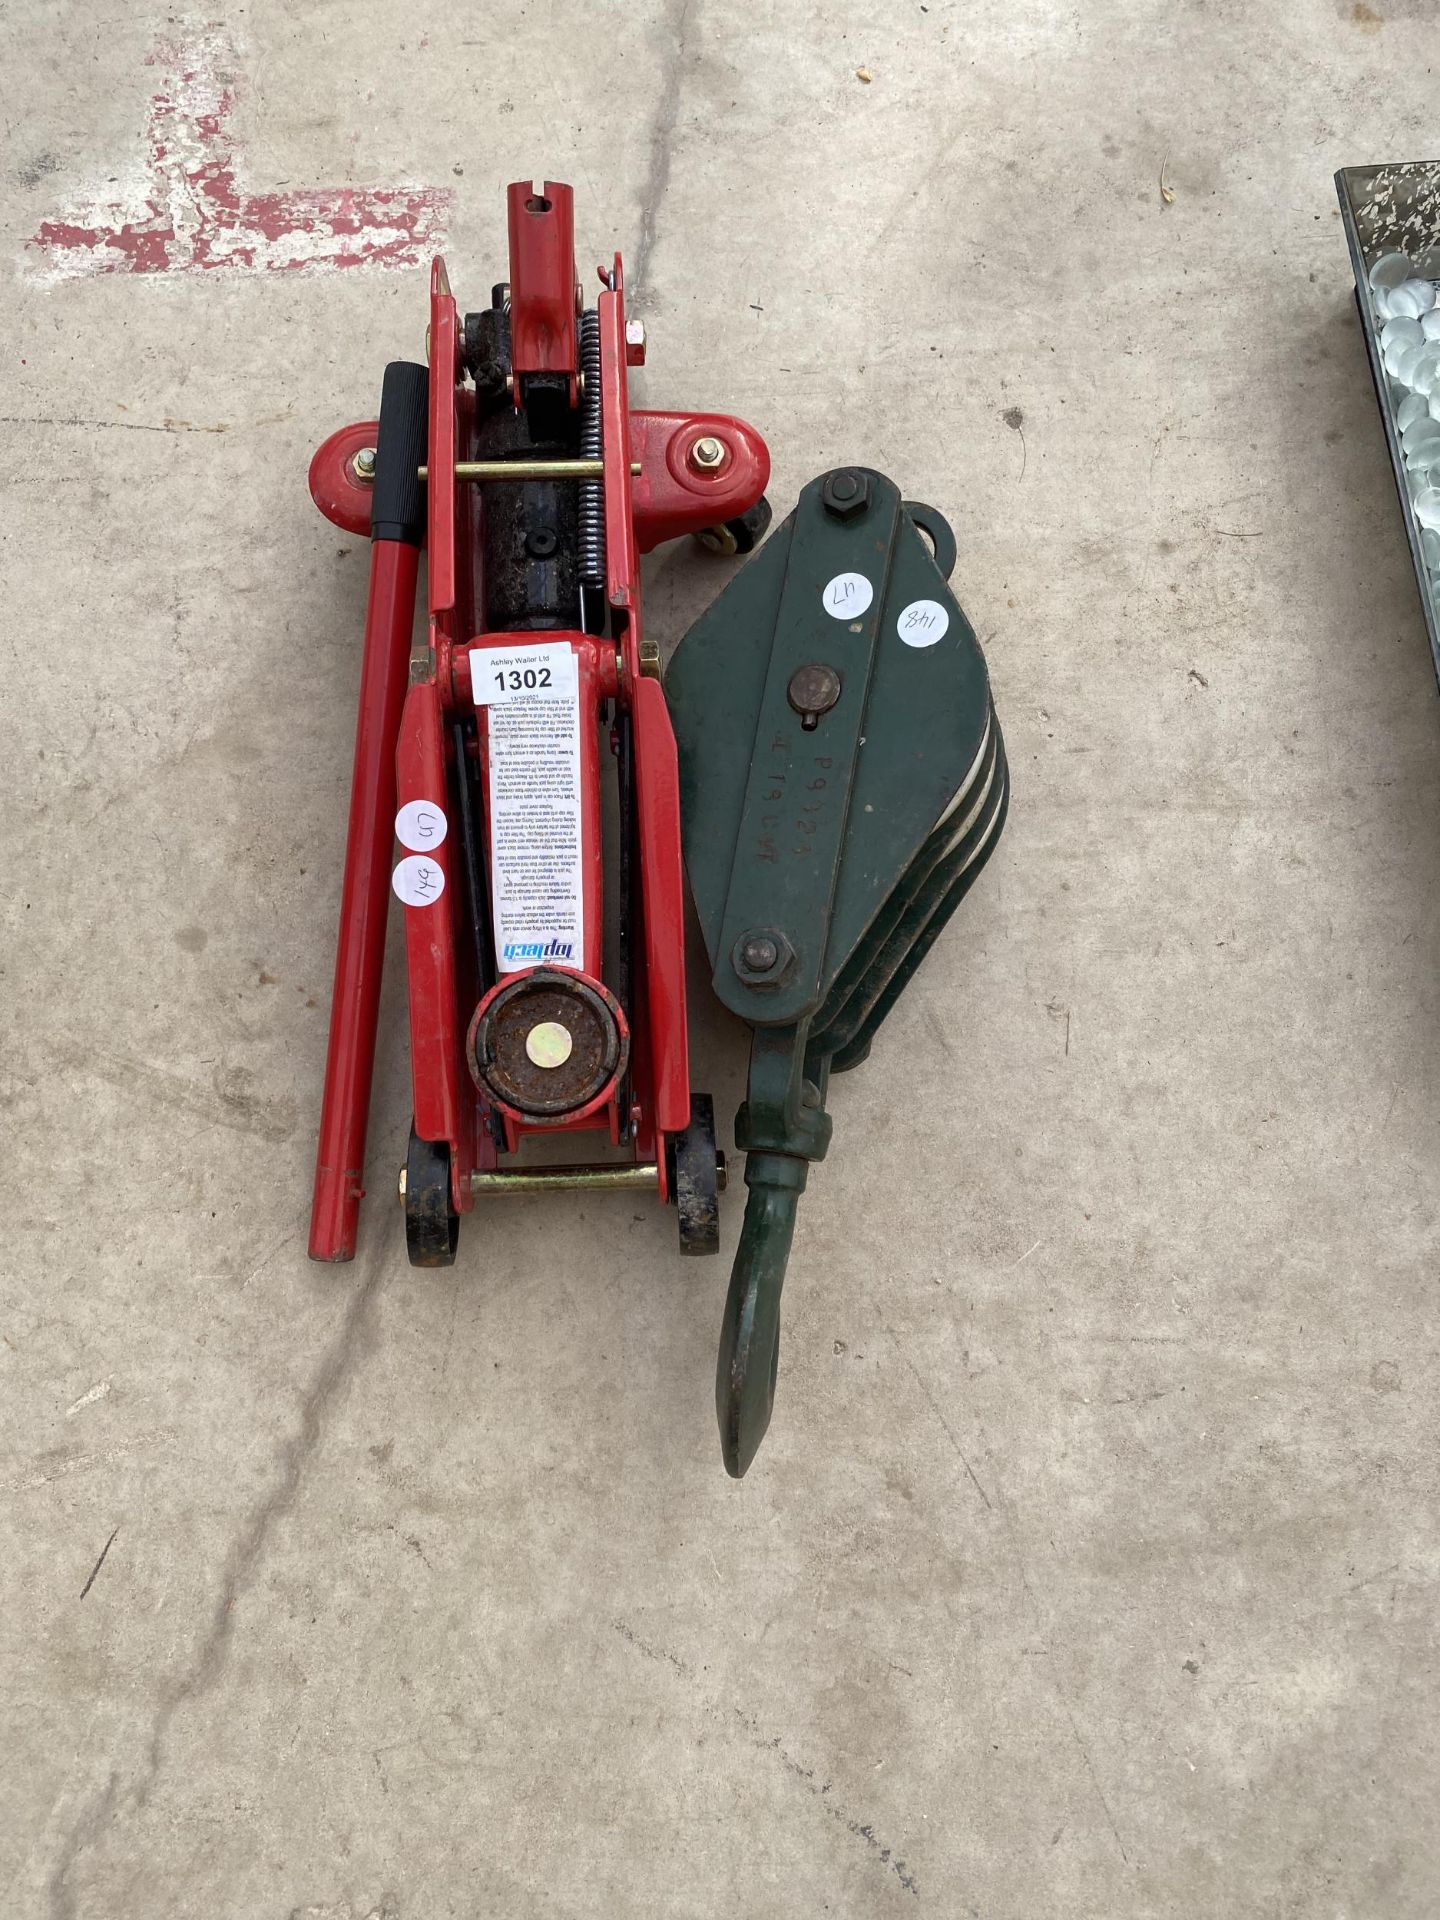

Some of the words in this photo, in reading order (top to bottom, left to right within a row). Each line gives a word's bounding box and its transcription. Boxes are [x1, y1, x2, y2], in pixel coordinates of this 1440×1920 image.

[904, 610, 937, 629] 148
[490, 658, 514, 667] Ashley
[494, 667, 552, 691] 1302
[414, 868, 437, 898] 149
